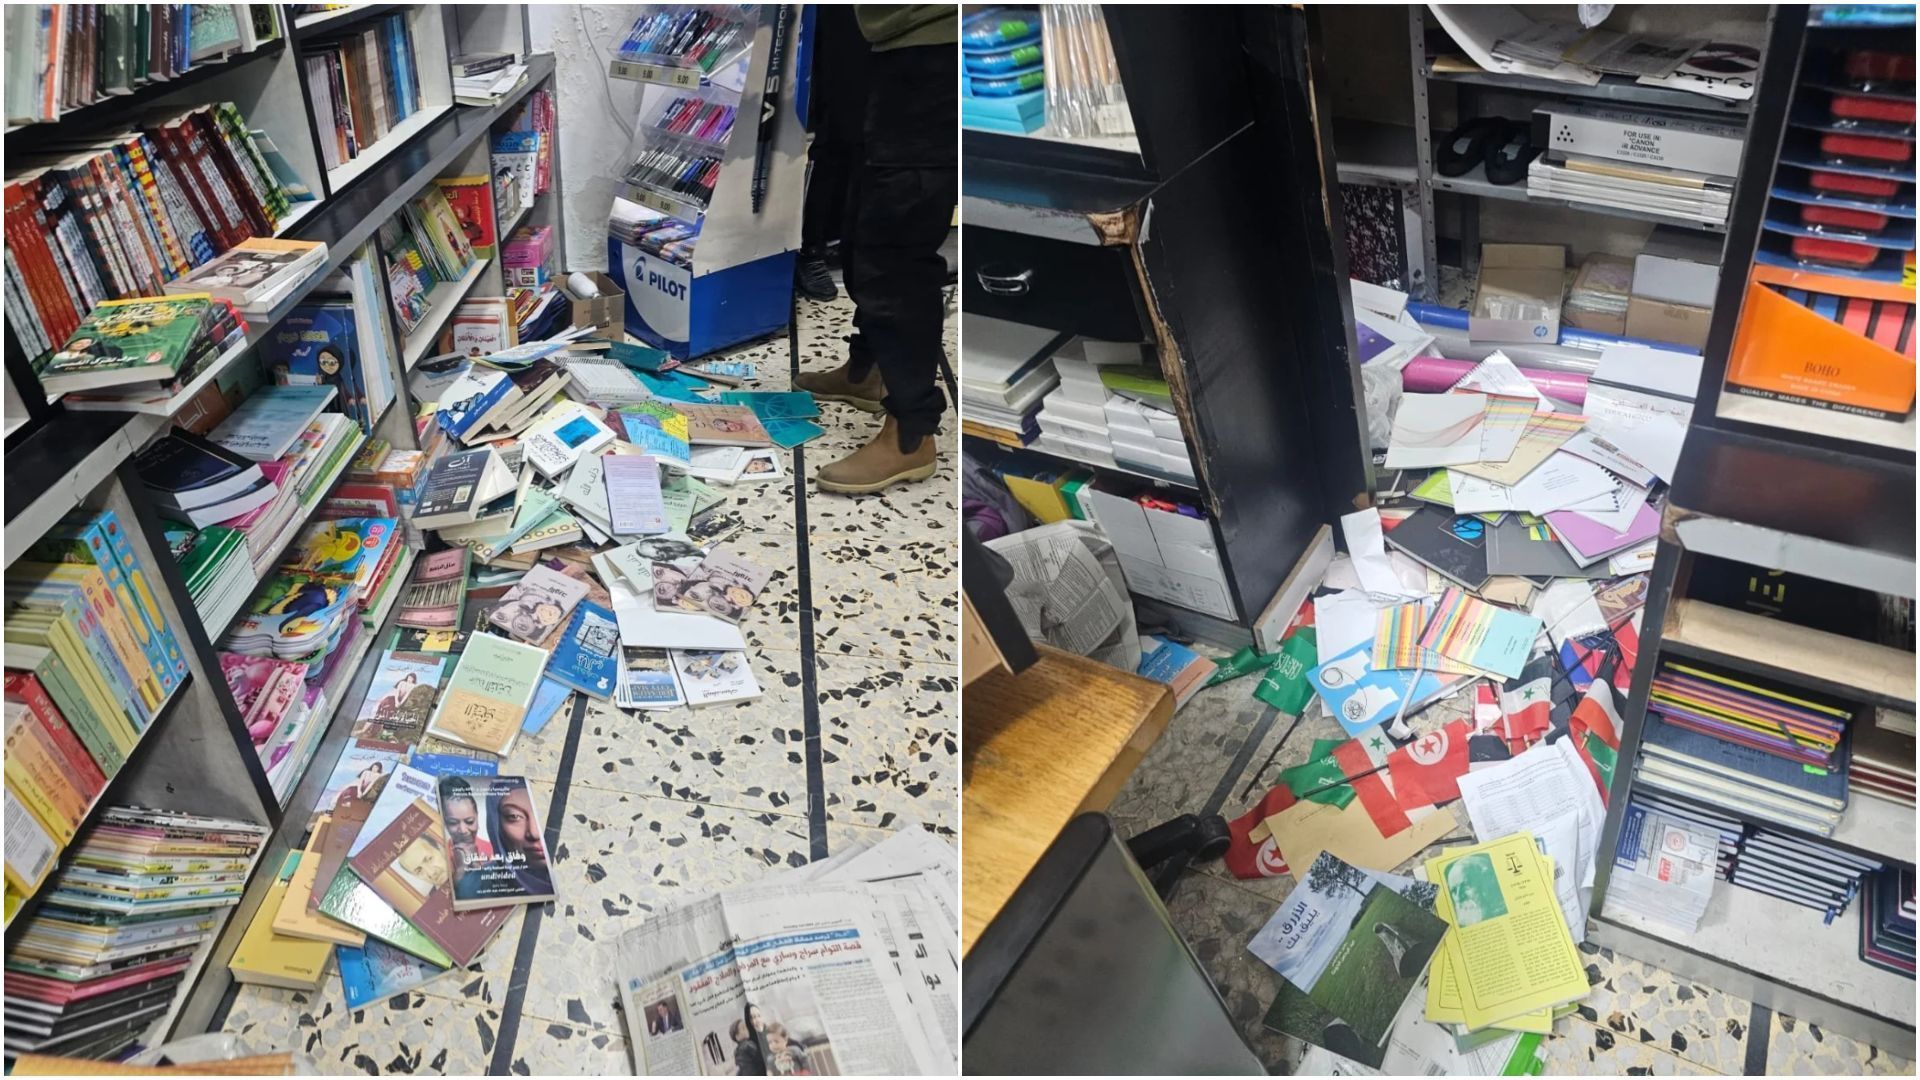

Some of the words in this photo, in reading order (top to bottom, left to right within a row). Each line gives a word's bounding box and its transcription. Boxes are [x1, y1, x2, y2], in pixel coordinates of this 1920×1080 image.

[771, 4, 788, 71] HI-TECPOI
[1623, 130, 1638, 138] FOR
[1638, 131, 1653, 139] USE
[1629, 144, 1661, 154] ADVANCE
[649, 272, 687, 301] PILOT
[1803, 361, 1840, 377] BOHO
[1740, 387, 1774, 398] QUALITY
[1811, 400, 1828, 408] THE
[1832, 403, 1887, 418] DIFFERENCE
[463, 851, 489, 865] شقاق
[489, 852, 505, 863] بعد
[505, 851, 526, 863] وفاق
[480, 870, 516, 881] undivided
[1281, 900, 1309, 936] الأزرق
[1299, 907, 1321, 934] يليق
[842, 941, 862, 952] قصة
[1285, 931, 1302, 951] بك
[798, 947, 819, 962] سراج
[820, 943, 841, 958] التوأم
[760, 956, 773, 967] مع
